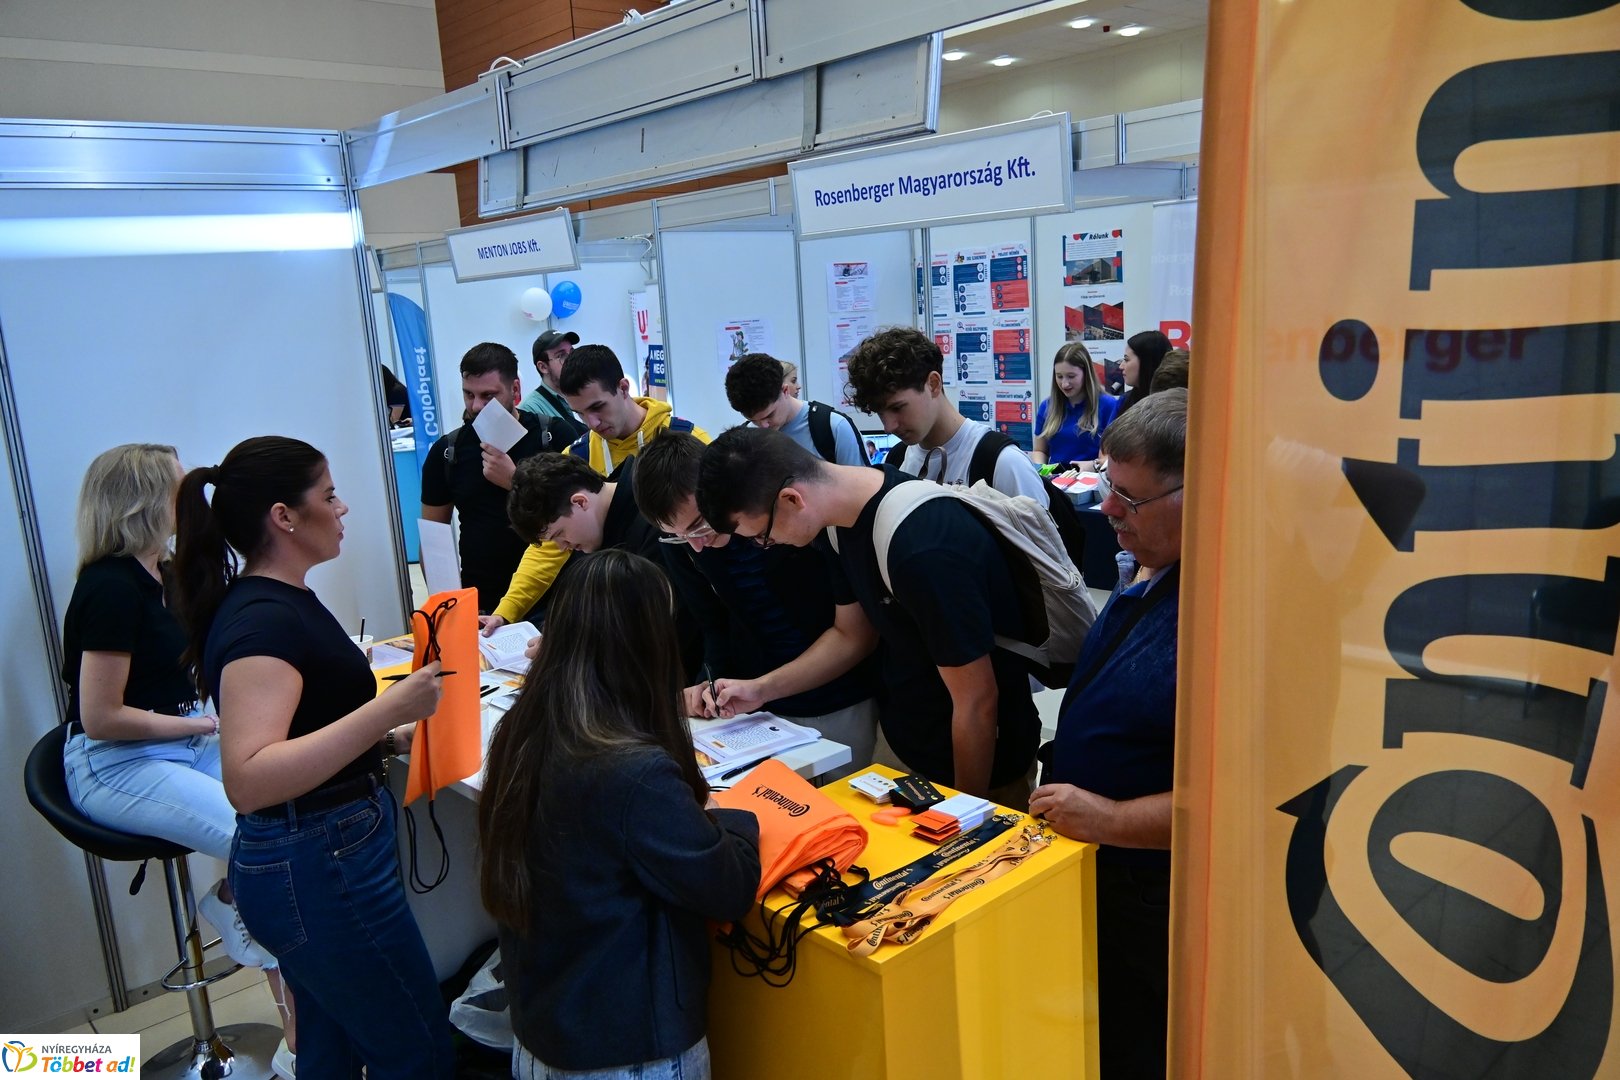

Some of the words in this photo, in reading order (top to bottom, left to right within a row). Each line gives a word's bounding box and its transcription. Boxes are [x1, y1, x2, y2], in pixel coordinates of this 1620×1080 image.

[814, 180, 895, 207] Rosenberger
[898, 161, 1003, 197] Magyarország
[1006, 156, 1036, 180] Kft.
[1088, 231, 1109, 241] Rólunk
[477, 244, 508, 260] MENTON
[509, 241, 527, 256] JOBS
[528, 238, 541, 253] Kft.
[1275, 0, 1620, 1080] Contin
[758, 786, 811, 817] Continental
[872, 869, 909, 890] Continental
[921, 879, 955, 902] Continental
[949, 878, 986, 898] Continental
